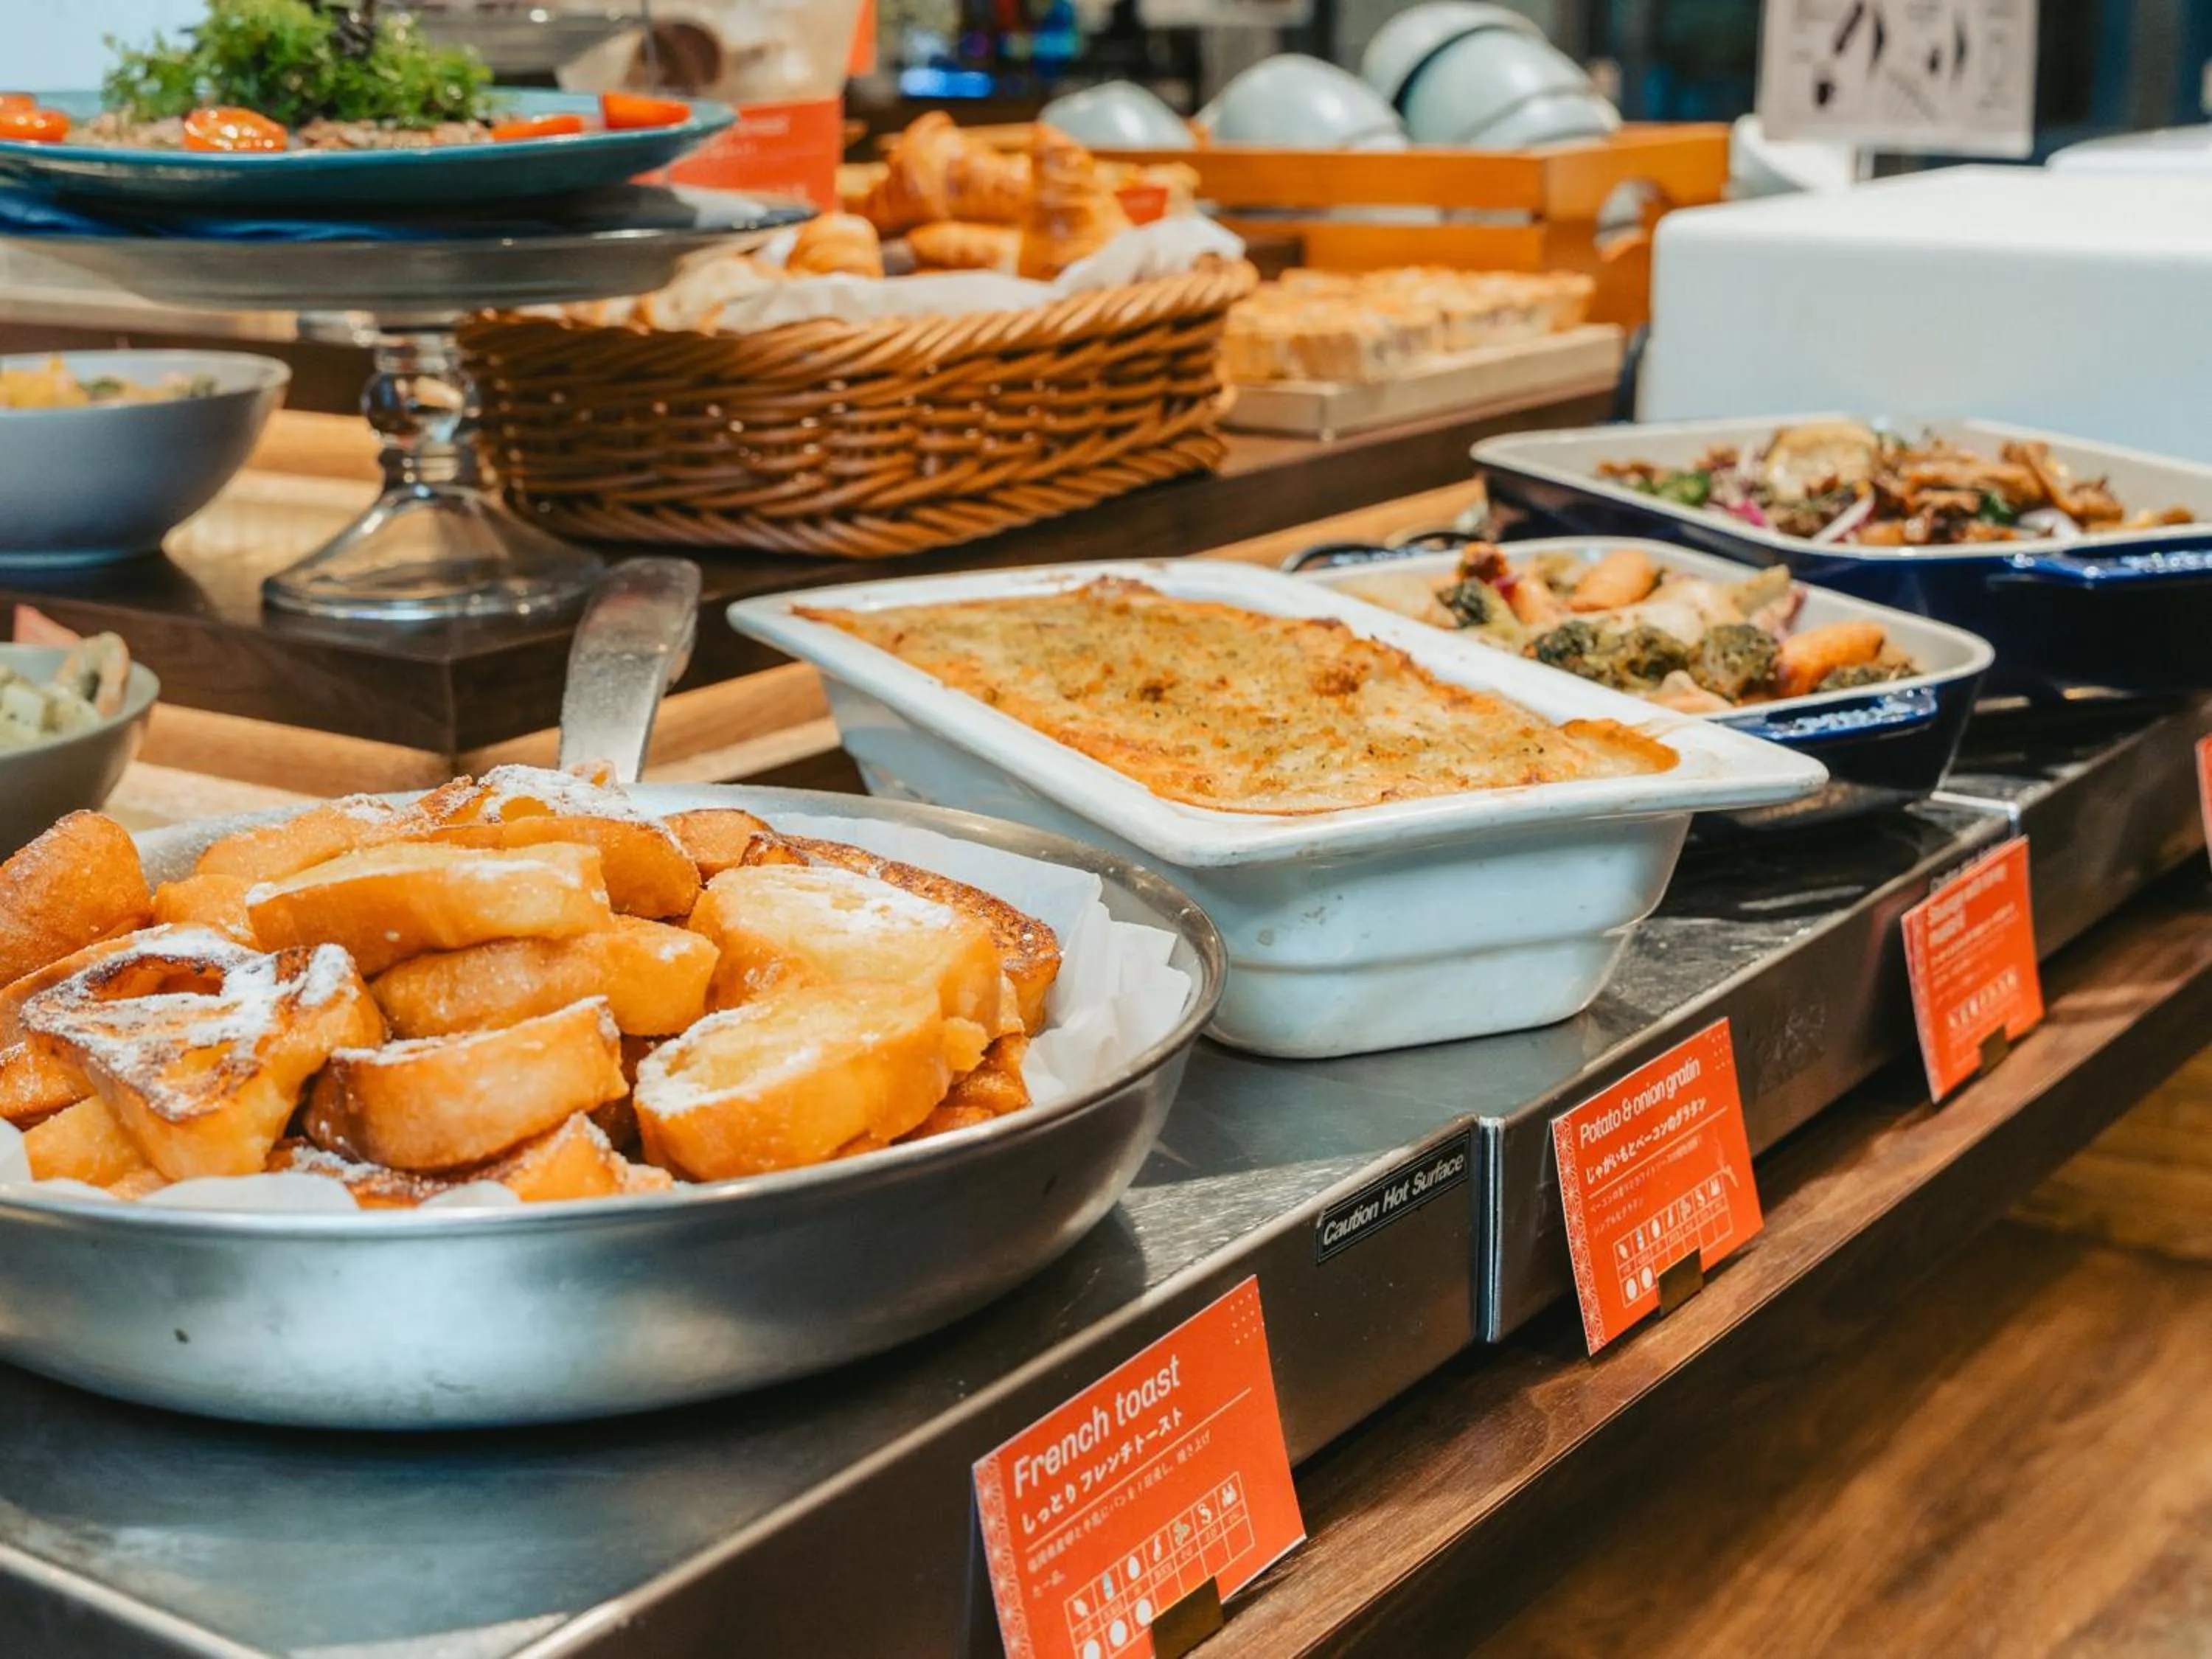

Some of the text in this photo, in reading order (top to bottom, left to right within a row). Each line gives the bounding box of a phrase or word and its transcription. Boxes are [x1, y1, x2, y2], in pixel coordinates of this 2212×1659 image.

[1580, 1057, 1700, 1148] Potato & onion gratin
[1324, 1154, 1464, 1245] Caution Hot Surface
[1015, 1354, 1180, 1498] French toast
